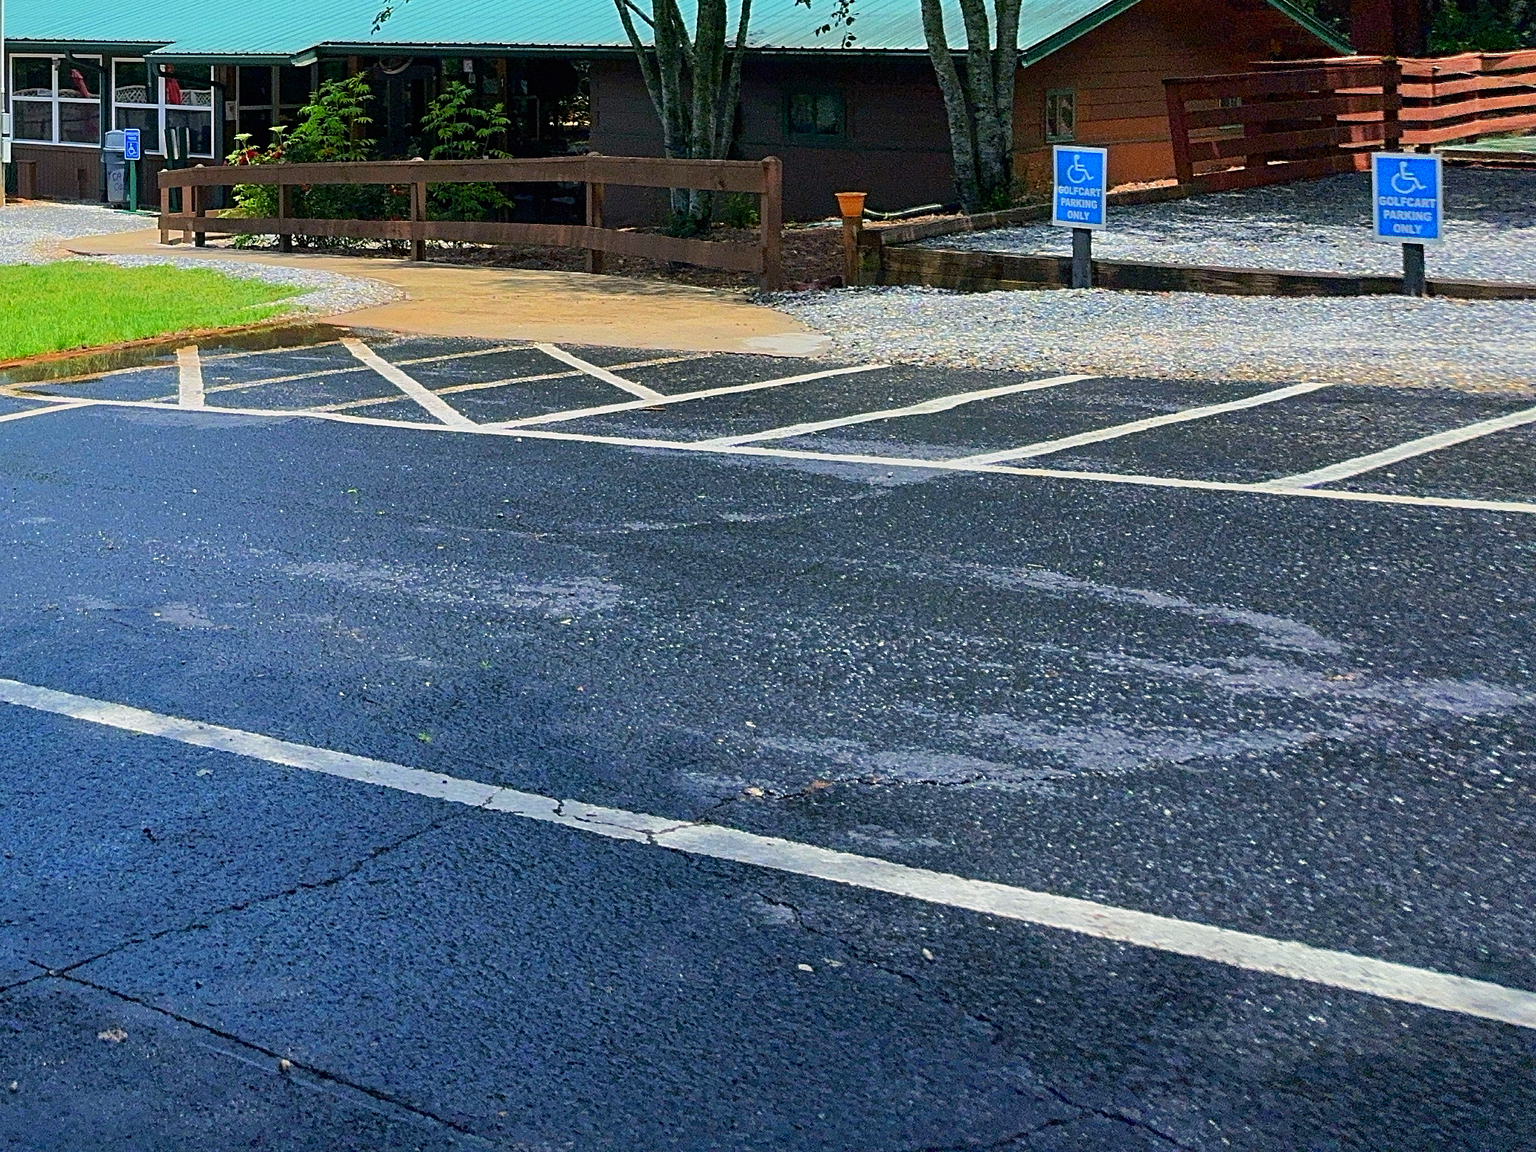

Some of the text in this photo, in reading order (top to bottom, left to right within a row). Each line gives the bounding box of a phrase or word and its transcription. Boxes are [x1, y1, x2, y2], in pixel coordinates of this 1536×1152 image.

[1058, 185, 1101, 198] GOLFCART
[1060, 198, 1098, 209] PARKING
[1378, 196, 1436, 209] GOLFCART
[1067, 210, 1090, 221] ONLY
[1383, 209, 1433, 222] PARKING
[1393, 223, 1422, 235] ONLY
